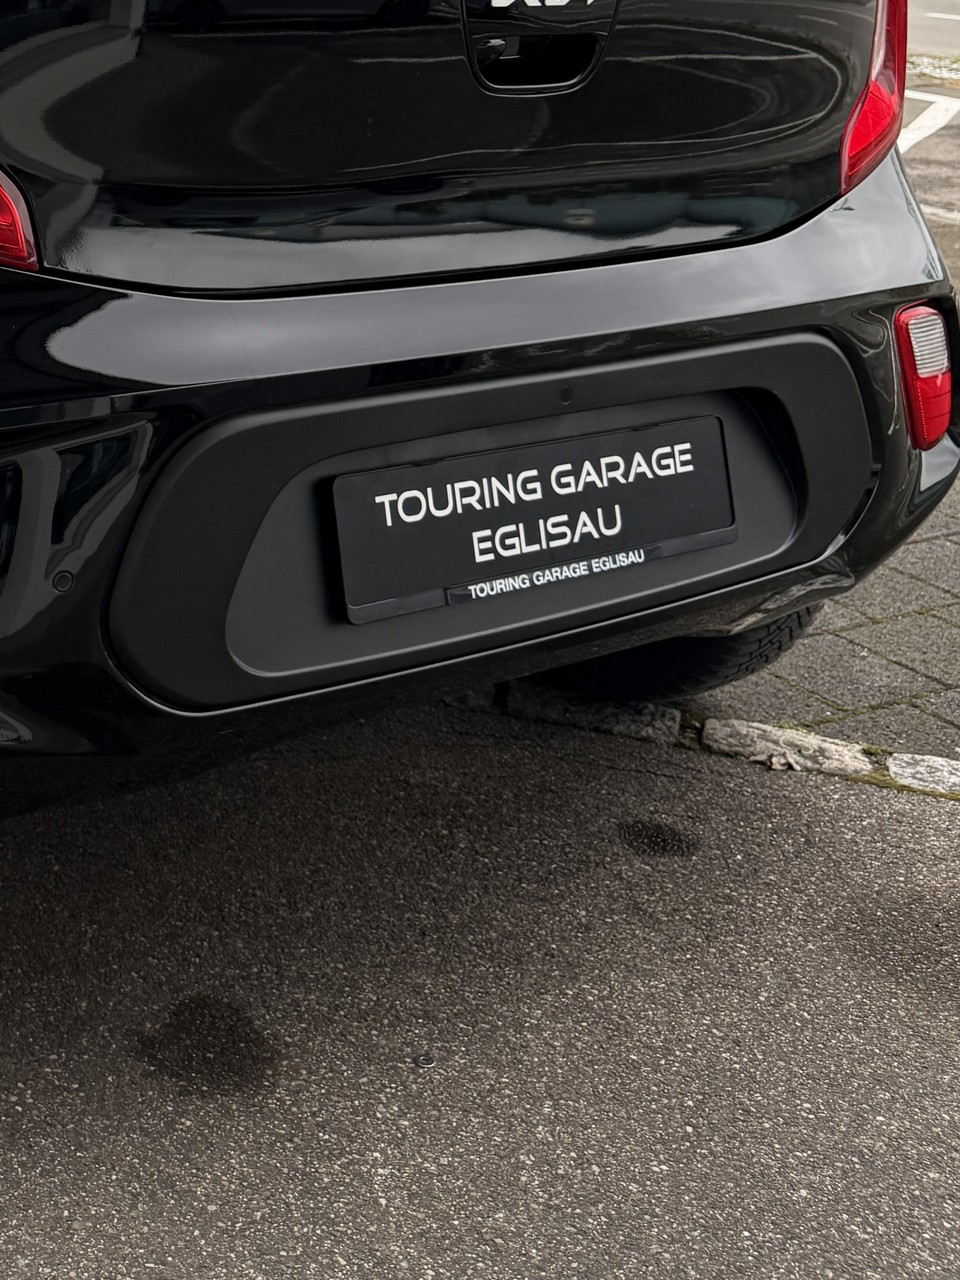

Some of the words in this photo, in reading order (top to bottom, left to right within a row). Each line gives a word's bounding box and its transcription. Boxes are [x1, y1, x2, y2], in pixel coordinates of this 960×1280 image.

[374, 468, 543, 527] TOURING
[550, 442, 695, 495] GARAGE
[471, 504, 622, 563] EGLISAU
[468, 573, 531, 599] TOURING
[532, 560, 590, 586] GARAGE
[590, 549, 645, 573] EGLISAU
